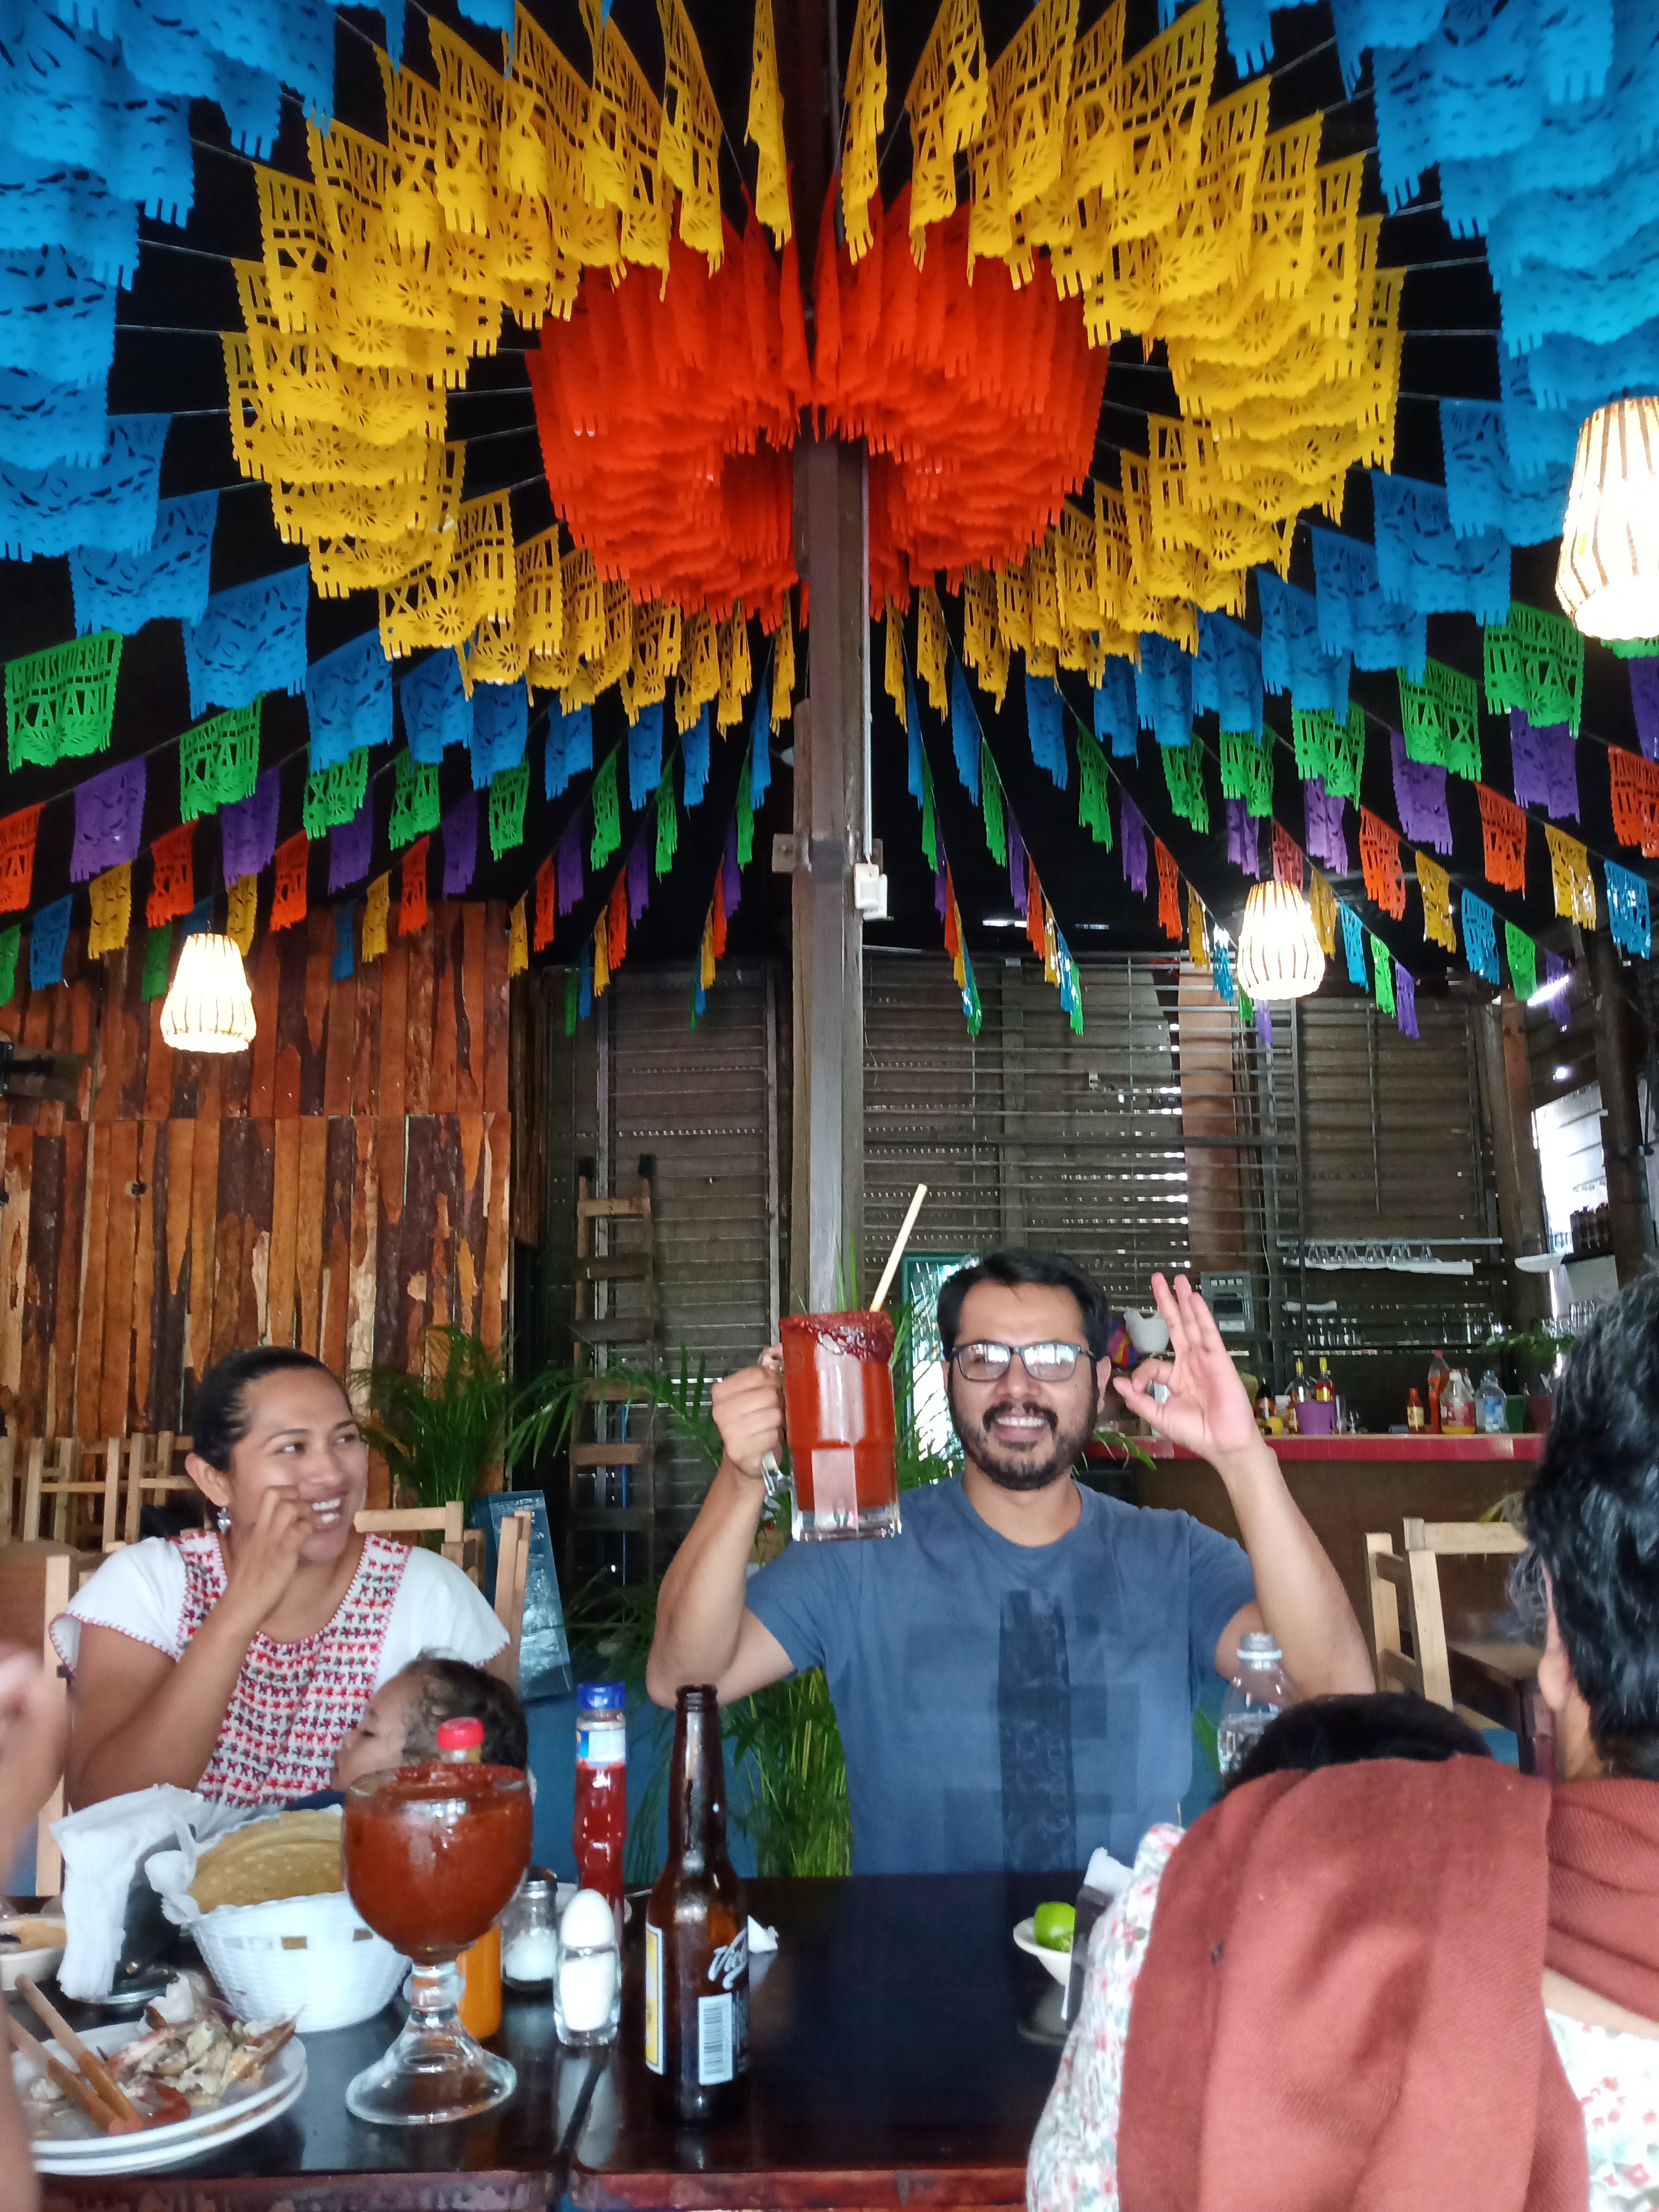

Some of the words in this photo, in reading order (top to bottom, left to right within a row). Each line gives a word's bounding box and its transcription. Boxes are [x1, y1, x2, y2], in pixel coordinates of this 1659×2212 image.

[13, 639, 110, 692] MARISUERIA
[14, 684, 105, 731] XAANI
[184, 736, 250, 786] XAANI
